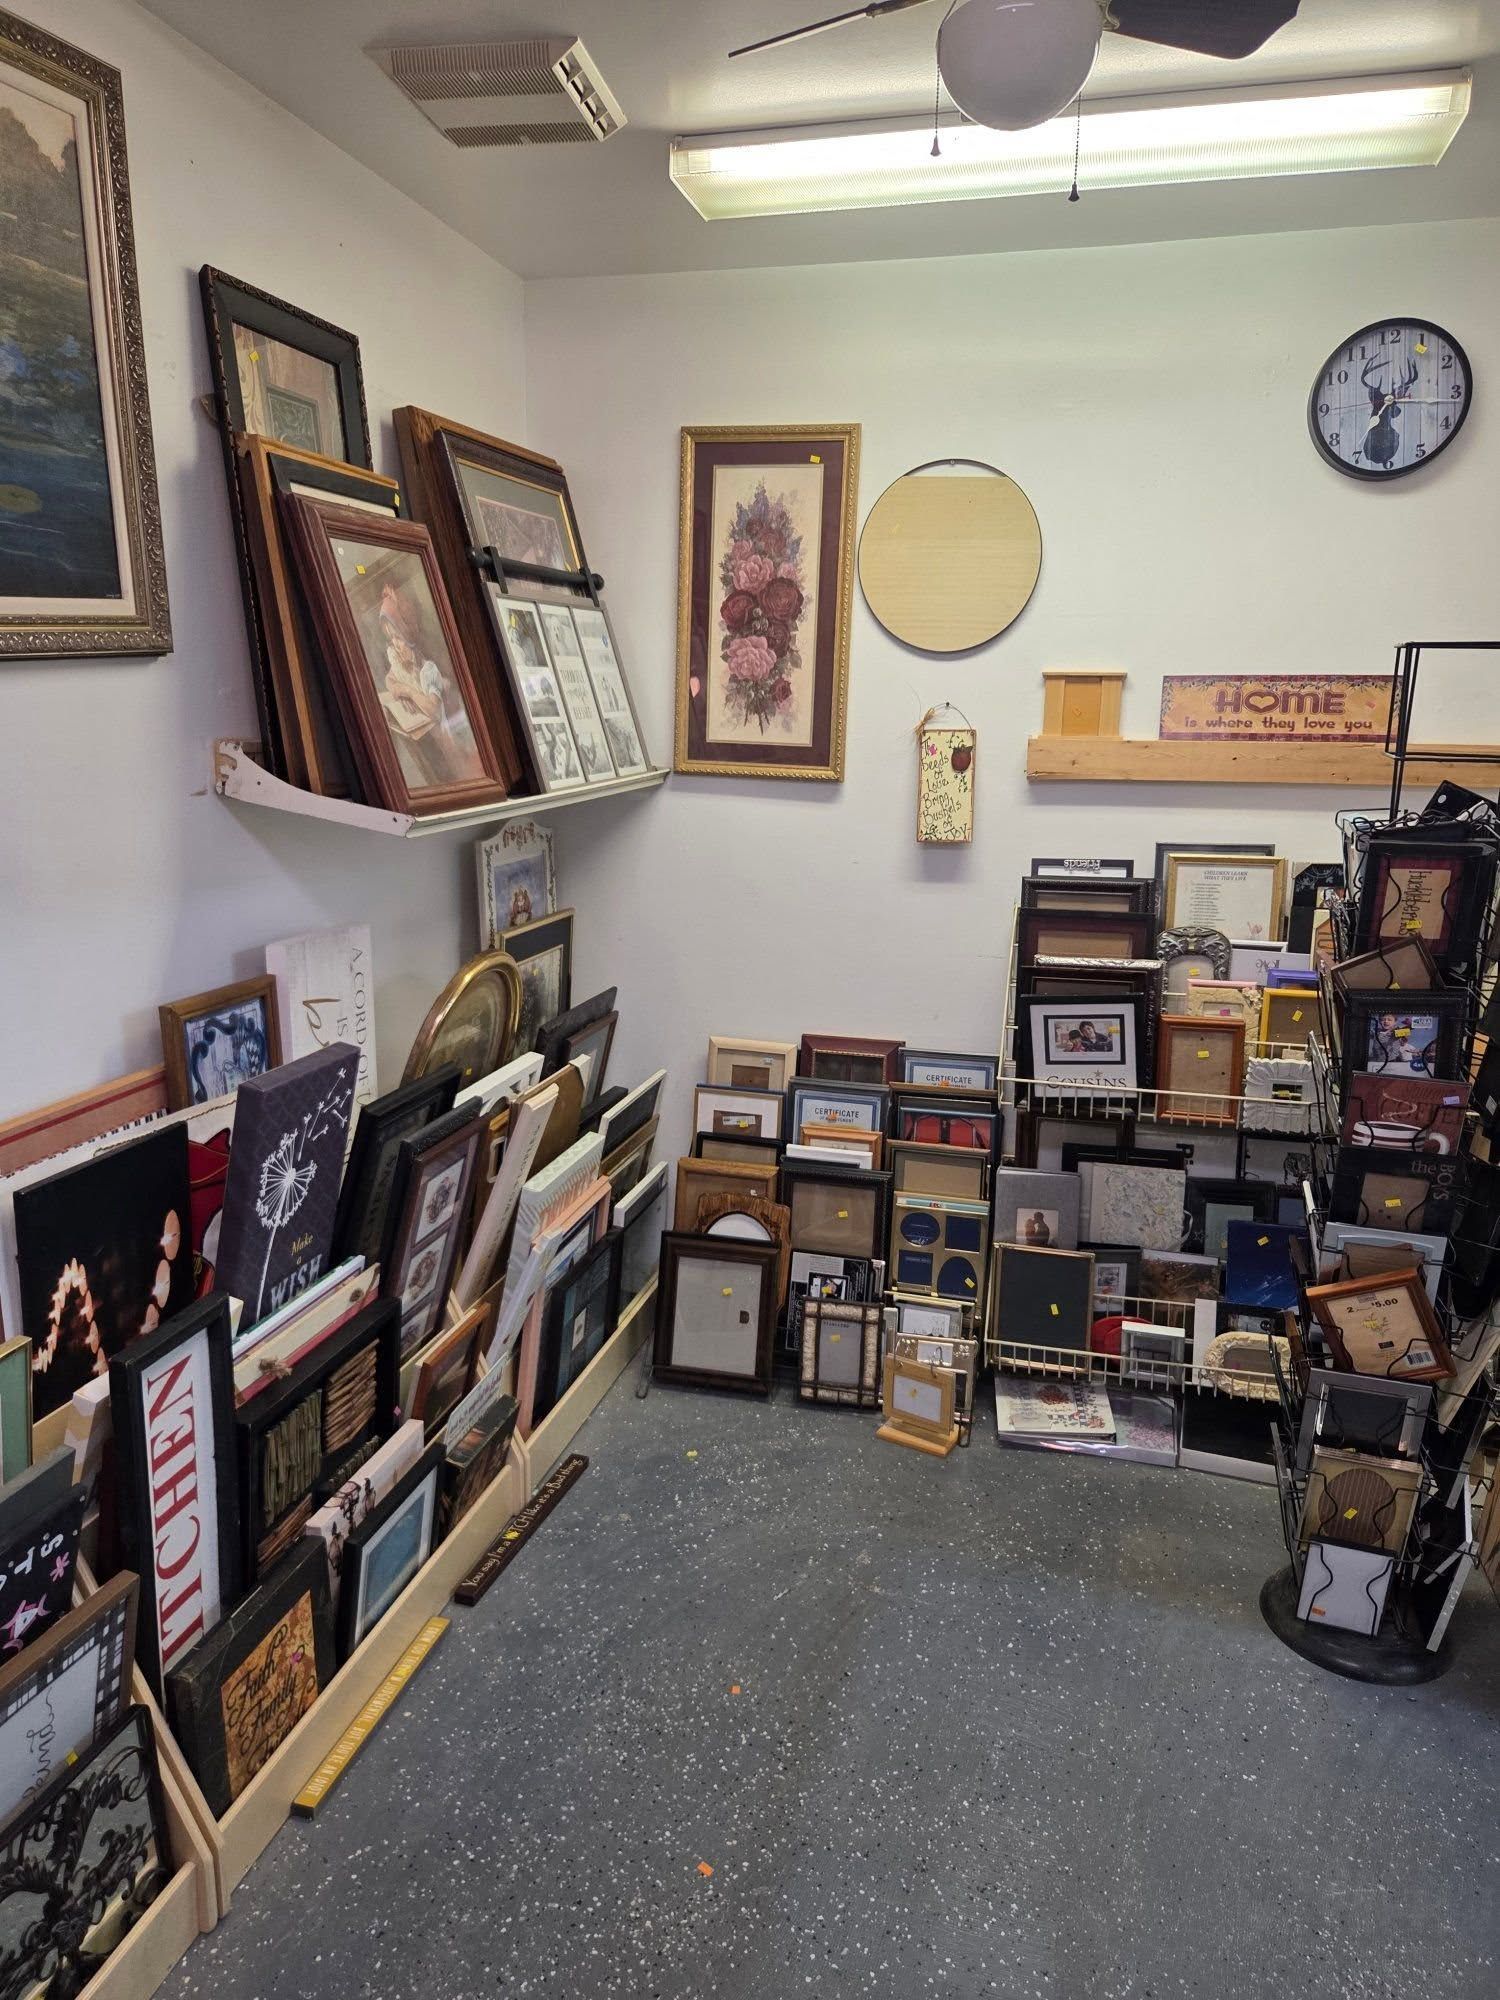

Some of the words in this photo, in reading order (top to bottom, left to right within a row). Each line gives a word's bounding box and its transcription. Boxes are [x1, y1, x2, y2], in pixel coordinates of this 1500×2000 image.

[1379, 329, 1401, 346] 12
[1346, 346, 1369, 362] 11
[1441, 354, 1453, 370] 2
[1326, 369, 1349, 386] 10
[1450, 384, 1462, 400] 3
[1318, 403, 1330, 418] 9
[1440, 415, 1452, 430] 4
[1328, 432, 1341, 447] 8
[1352, 450, 1363, 465] 7
[1415, 443, 1427, 458] 5
[1215, 689, 1347, 715] HOME
[1184, 716, 1198, 728] is
[1206, 716, 1253, 729] where
[1262, 716, 1296, 732] they
[1304, 716, 1336, 729] love
[1344, 719, 1373, 732] you
[351, 947, 363, 963] A
[353, 971, 368, 1046] CORD
[926, 1074, 972, 1085] CERTIFICATE
[814, 1107, 860, 1119] CERTIFICATE
[1411, 1160, 1437, 1175] the
[290, 1232, 314, 1256] Make
[271, 1253, 323, 1312] WISH
[561, 1458, 583, 1475] thing
[545, 1473, 566, 1489] Bad
[147, 1353, 205, 1669] ITCHEN
[524, 1503, 543, 1516] like
[488, 1545, 506, 1560] I'm
[482, 1557, 500, 1572] say
[462, 1567, 484, 1587] You
[226, 1623, 288, 1728] Faith
[238, 1645, 306, 1756] Family
